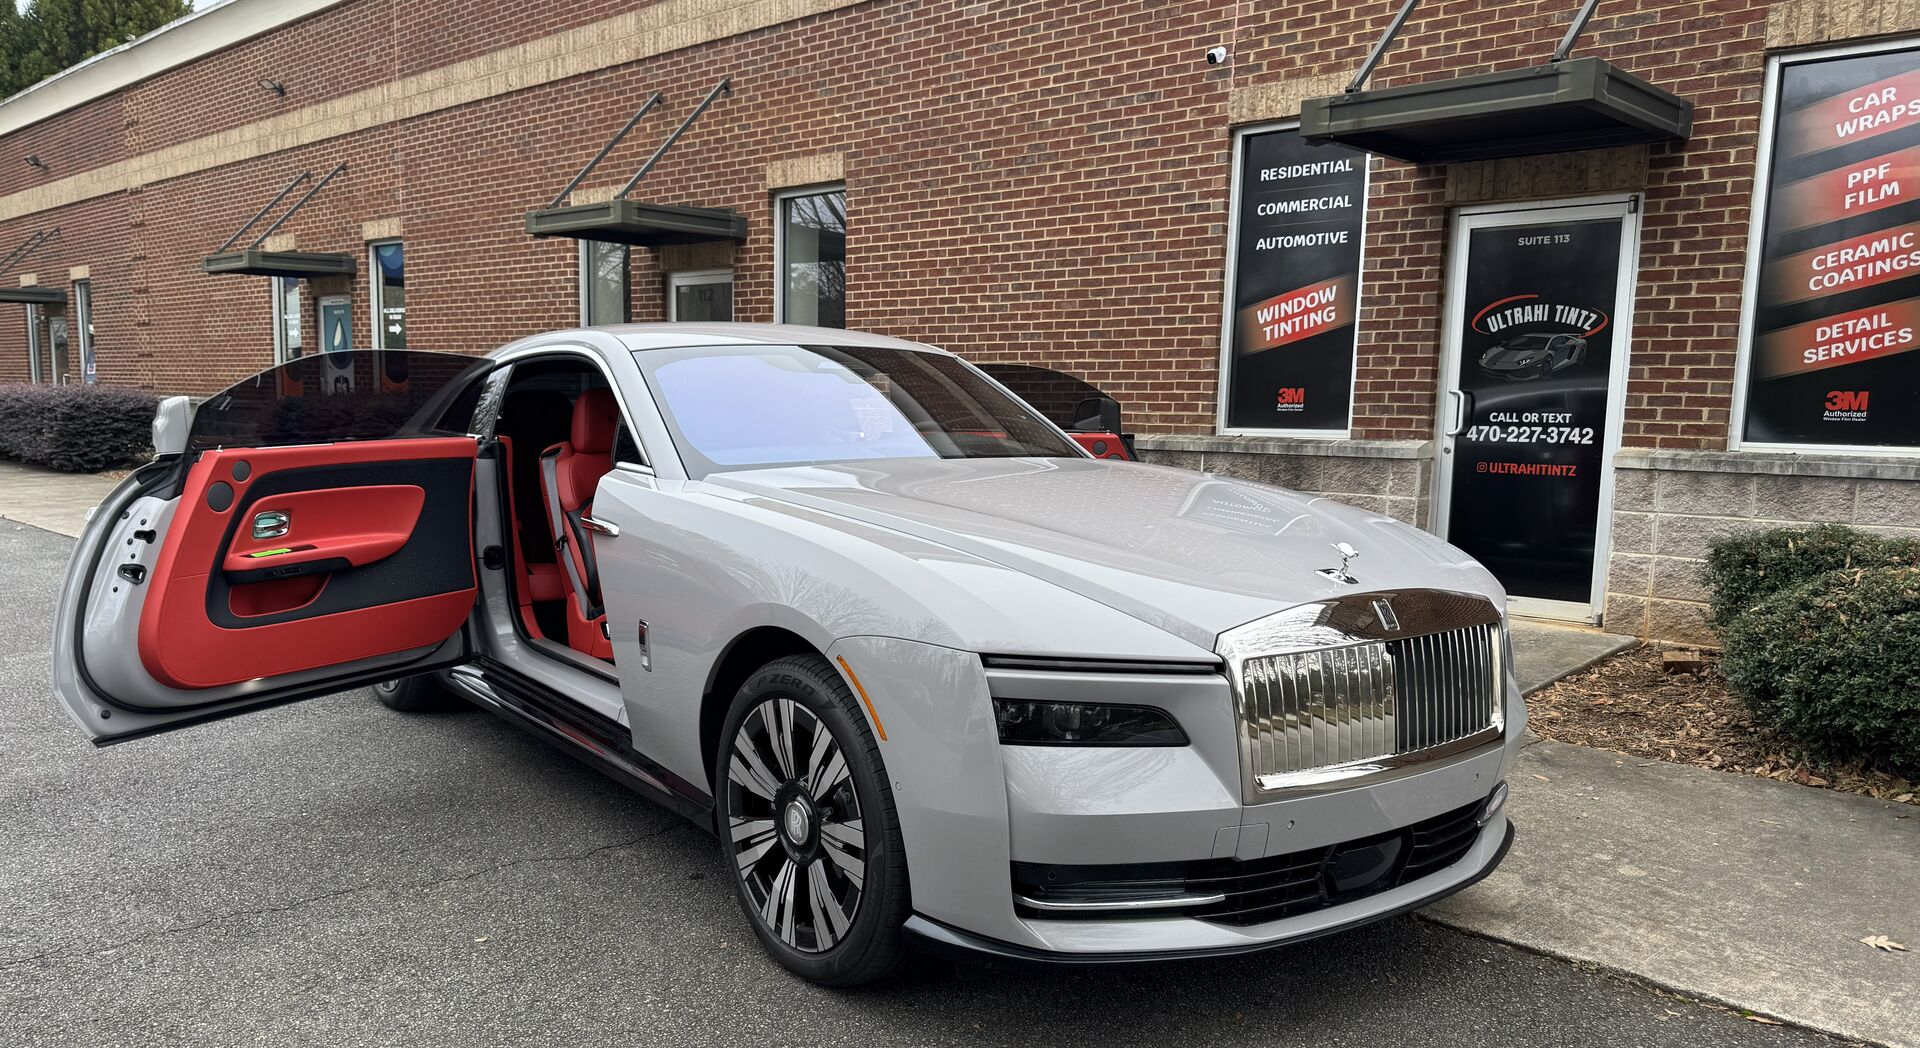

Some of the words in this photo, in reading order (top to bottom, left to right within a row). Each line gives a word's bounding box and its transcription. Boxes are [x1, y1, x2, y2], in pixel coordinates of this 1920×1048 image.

[1849, 86, 1897, 114] CAR
[1835, 99, 1920, 138] WRAPS
[1260, 159, 1353, 182] RESIDENTIAL
[1847, 162, 1891, 189] PPF
[1257, 194, 1352, 217] COMMERCIAL
[1844, 181, 1900, 210] FILM
[1255, 230, 1349, 251] AUTOMOTIVE
[1518, 235, 1551, 246] SUITE
[1554, 234, 1571, 244] 113
[1811, 232, 1915, 271] CERAMIC
[1808, 250, 1920, 292] COATINGS
[1256, 285, 1337, 324] WINDOW
[1263, 306, 1336, 342] TINTING
[1486, 304, 1549, 333] ULTRAHI
[1555, 304, 1598, 331] TINTZ
[1816, 312, 1893, 343] DETAIL
[1803, 327, 1913, 364] SERVICES
[1278, 387, 1304, 403] 3M
[1824, 390, 1869, 411] 3M
[1489, 412, 1519, 423] CALL
[1522, 412, 1539, 423] OR
[1541, 413, 1573, 424] TEXT
[1823, 410, 1867, 418] Authorized
[1466, 425, 1594, 445] 470-227-3742
[1489, 462, 1577, 477] ULTRAHITINTZ
[769, 673, 816, 697] ZERO
